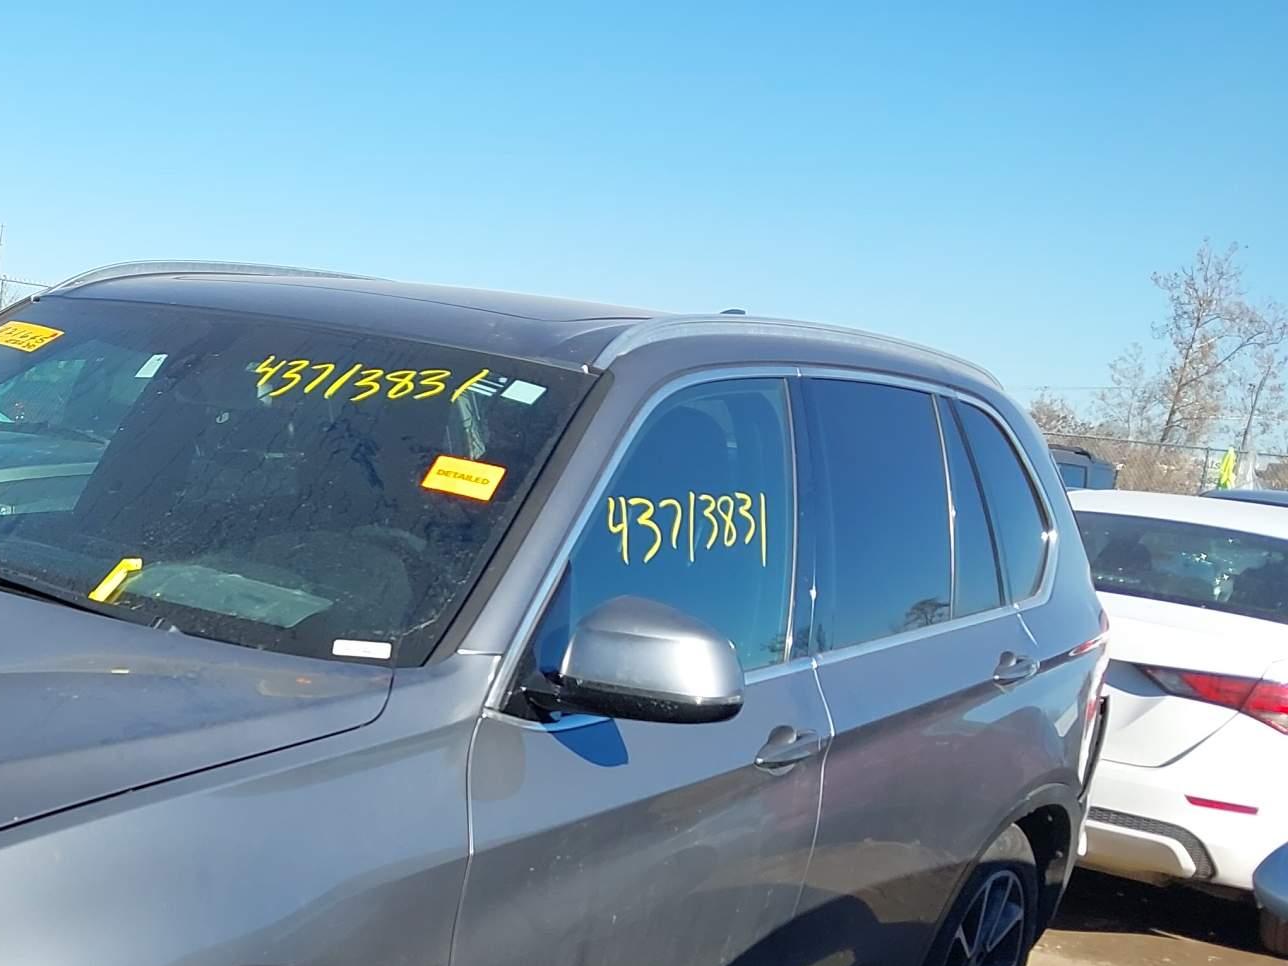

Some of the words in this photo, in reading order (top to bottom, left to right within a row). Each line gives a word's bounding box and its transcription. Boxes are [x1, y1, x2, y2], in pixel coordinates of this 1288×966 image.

[255, 355, 490, 402] 43713831
[436, 469, 491, 485] DETAILED
[607, 491, 768, 567] 43713831
